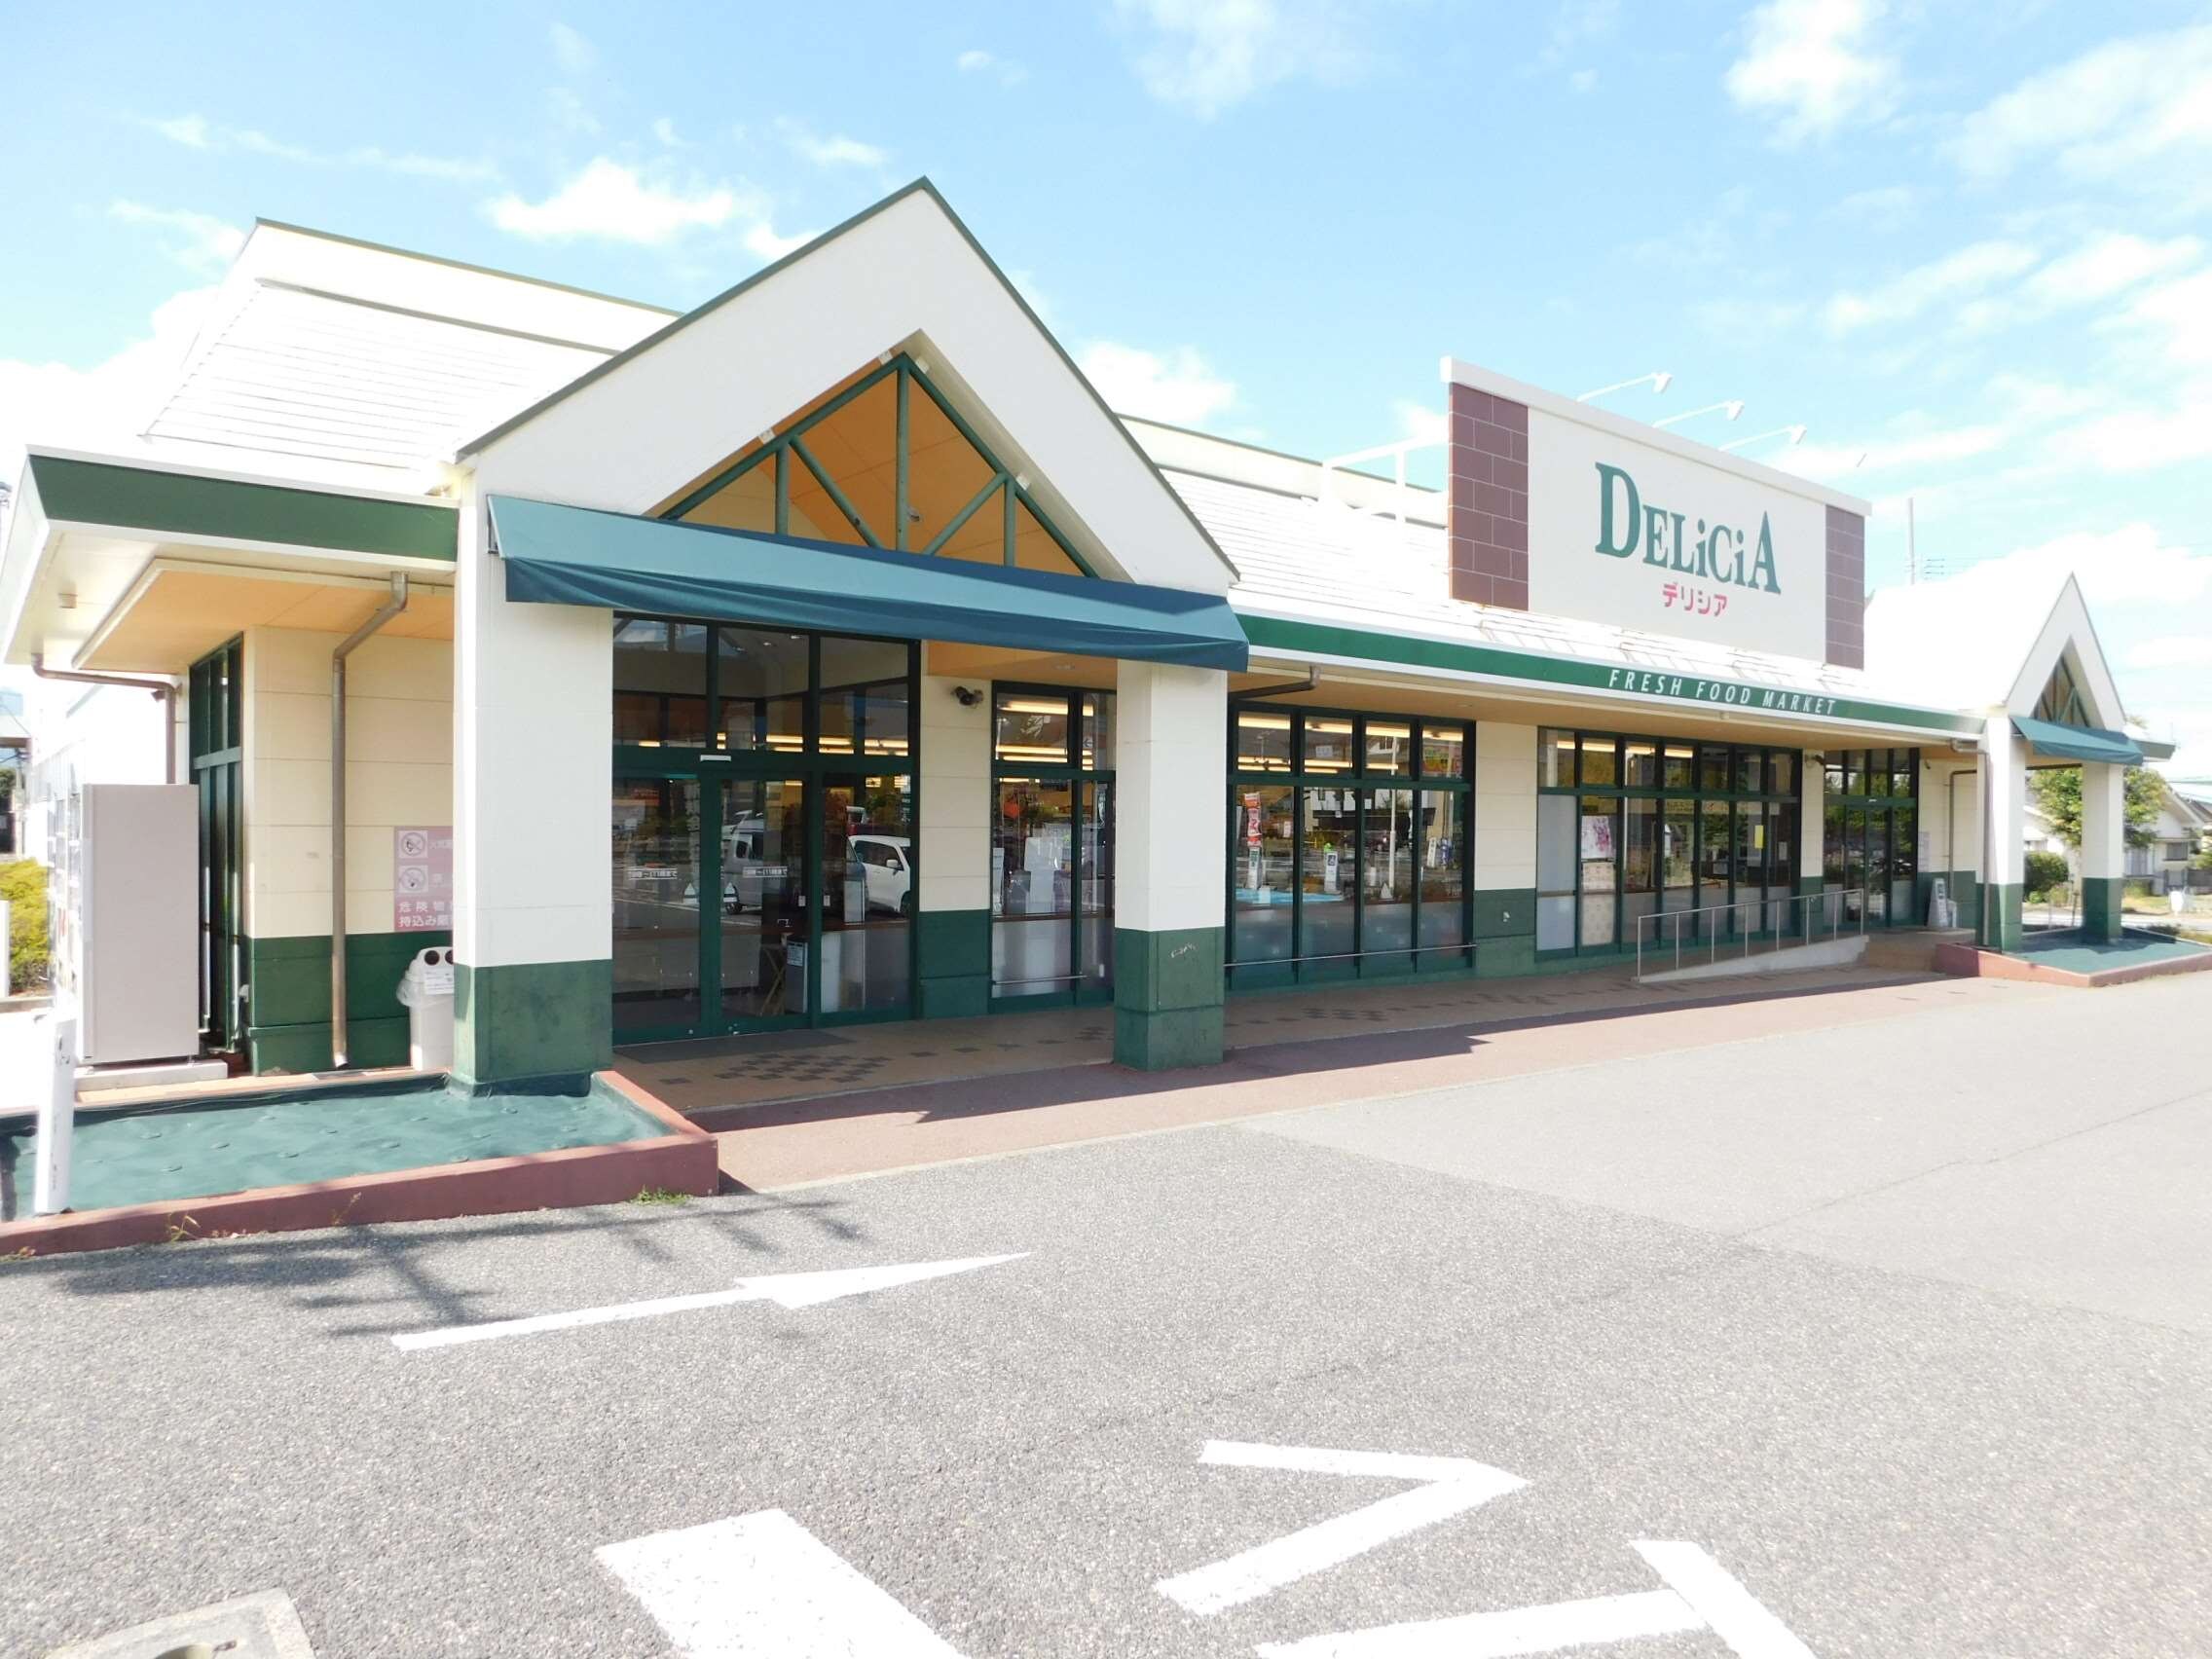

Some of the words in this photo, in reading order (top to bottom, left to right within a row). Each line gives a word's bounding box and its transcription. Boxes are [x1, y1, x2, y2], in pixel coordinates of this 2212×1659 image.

[1662, 581, 1728, 617] デリシア
[1608, 669, 1682, 695] FRESH
[1695, 681, 1751, 705] FOOD
[1761, 690, 1837, 716] MARKET
